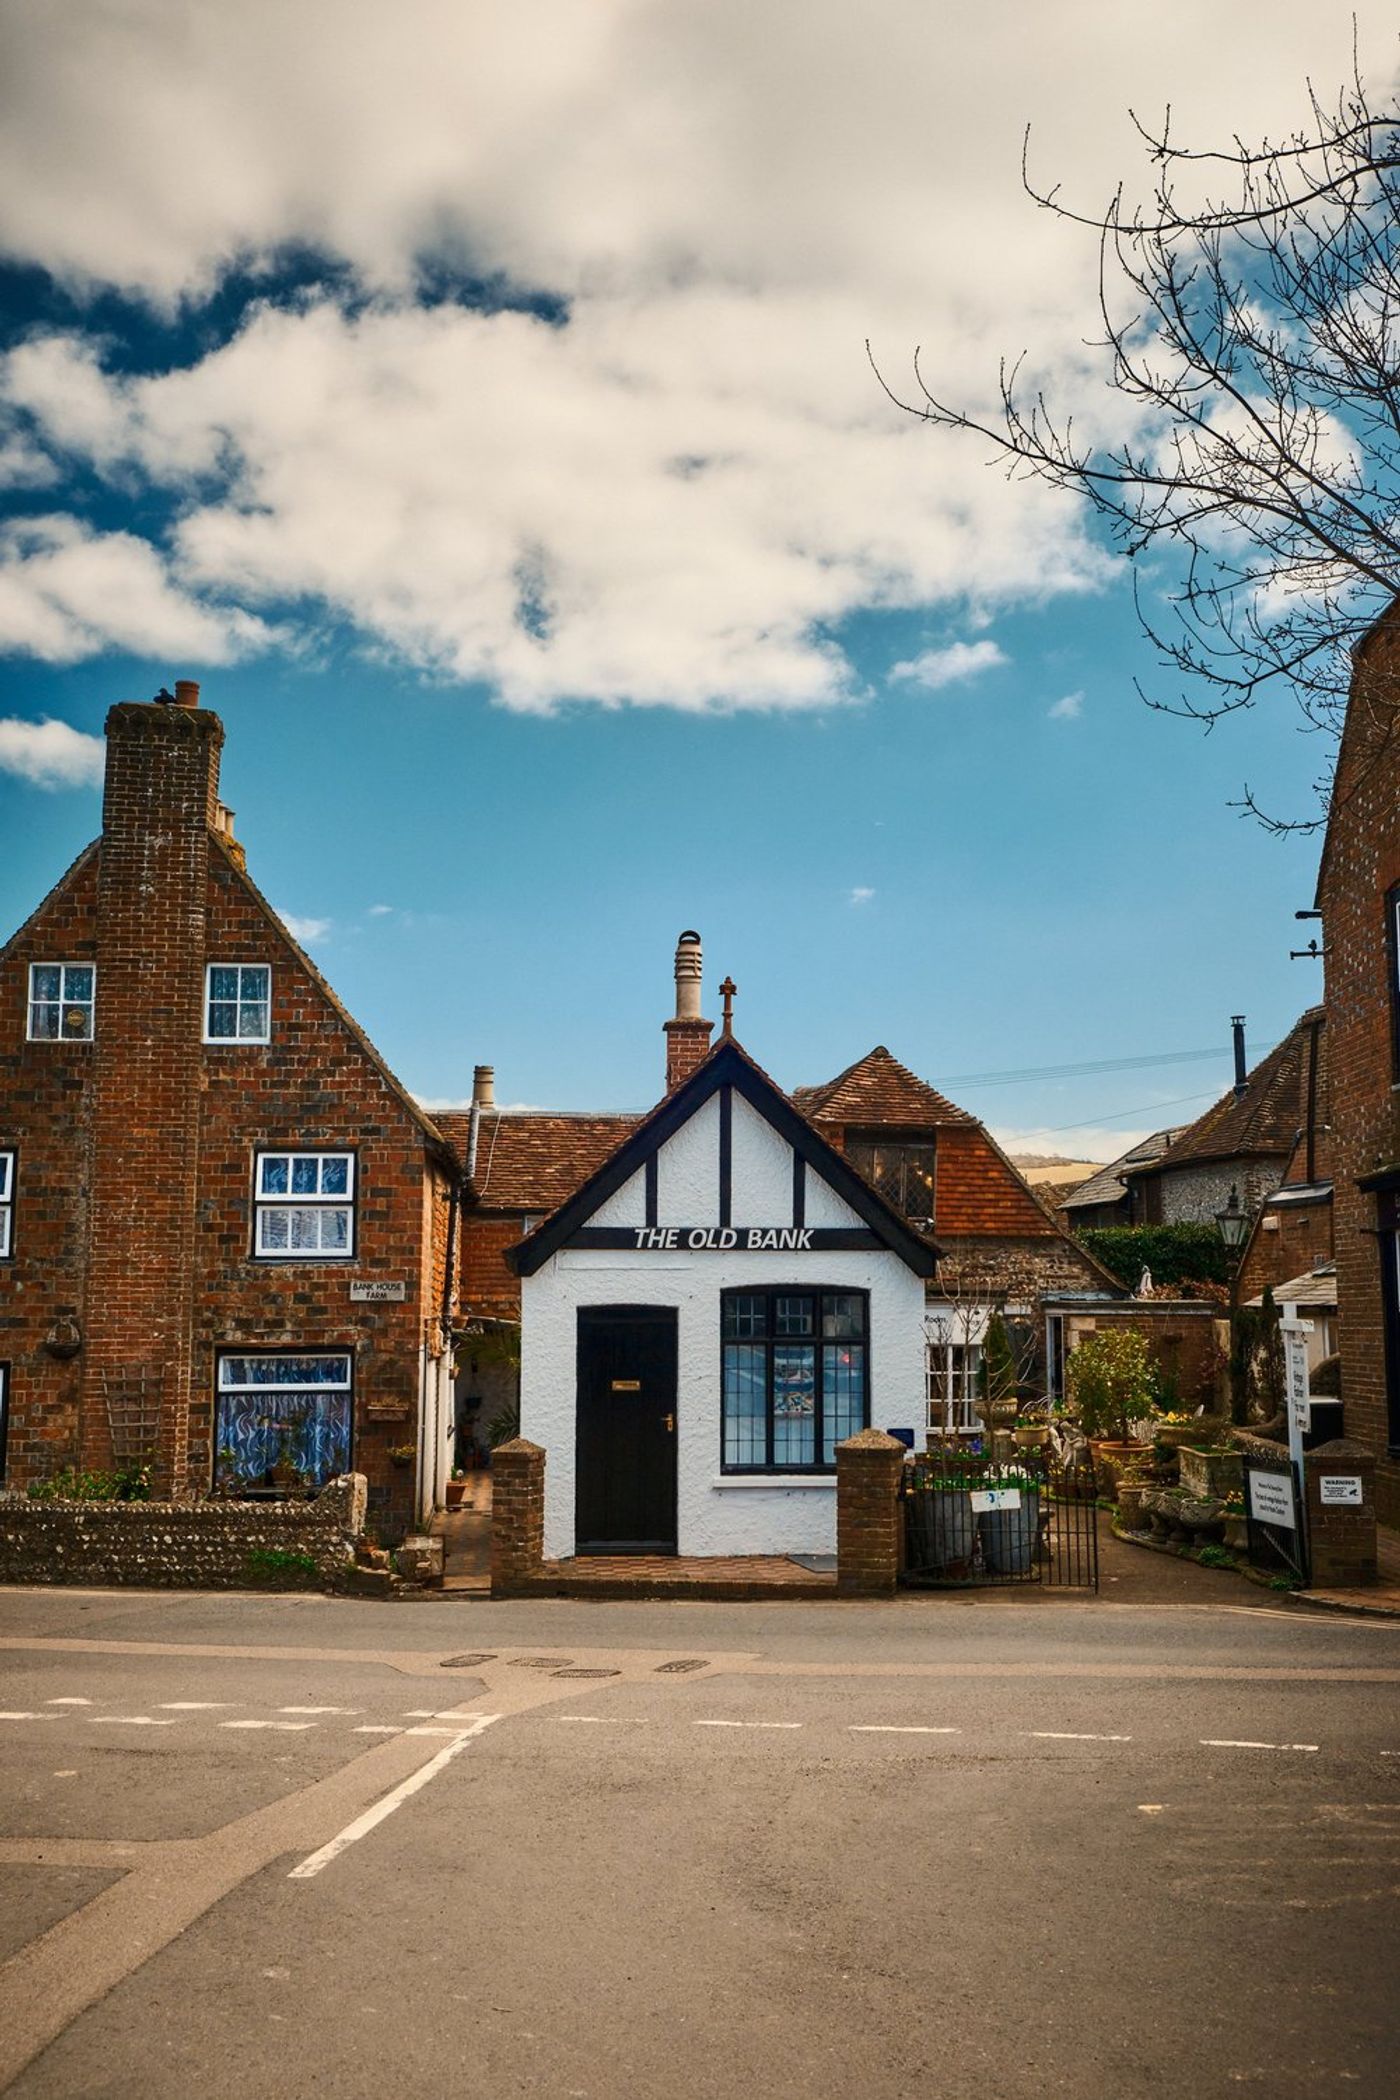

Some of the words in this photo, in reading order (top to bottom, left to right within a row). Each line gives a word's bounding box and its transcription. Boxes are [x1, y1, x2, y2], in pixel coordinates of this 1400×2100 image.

[634, 1228, 680, 1249] THE
[688, 1228, 737, 1249] OLD
[747, 1228, 815, 1249] BANK
[377, 1283, 401, 1291] HOUSE
[366, 1291, 387, 1299] FARM
